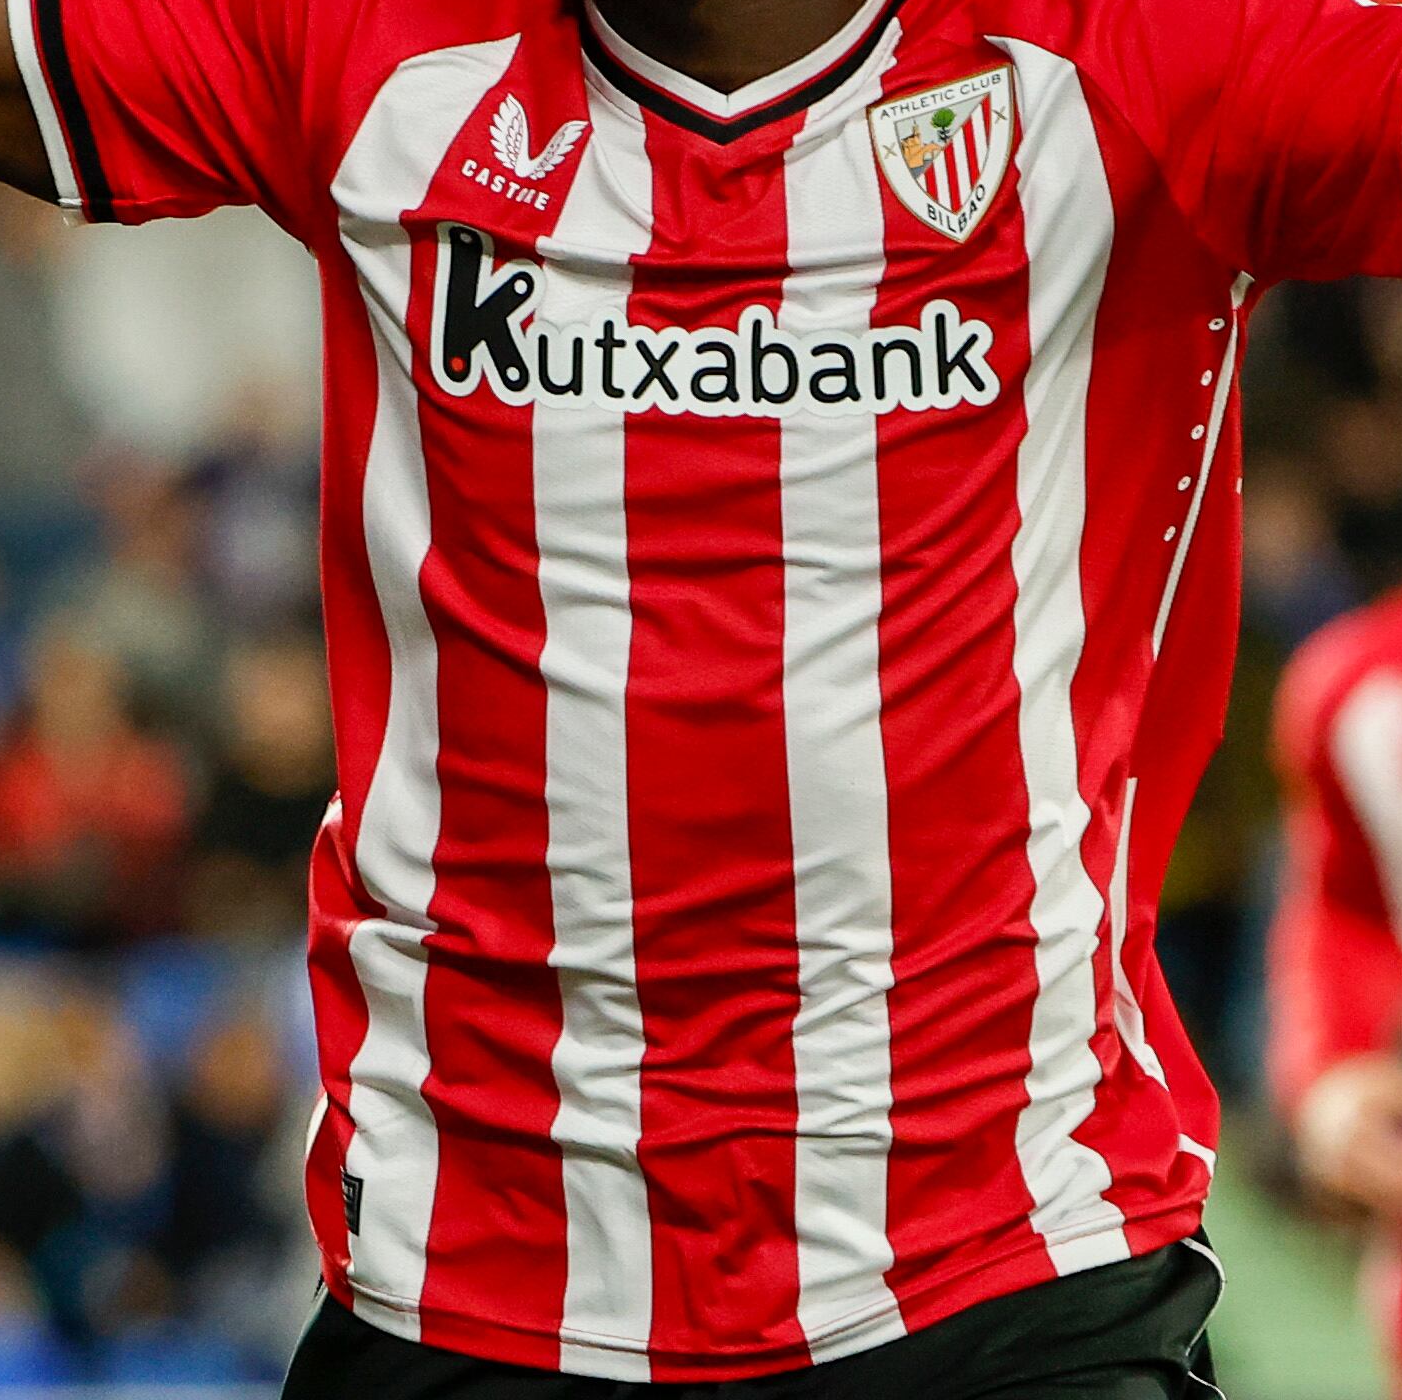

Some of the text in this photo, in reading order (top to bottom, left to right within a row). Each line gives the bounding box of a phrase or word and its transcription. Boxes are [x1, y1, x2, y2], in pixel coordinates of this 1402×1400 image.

[880, 73, 1002, 120] ATHLETIC CLUB
[926, 184, 986, 234] BILBAO
[443, 225, 986, 404] Kutxabank
